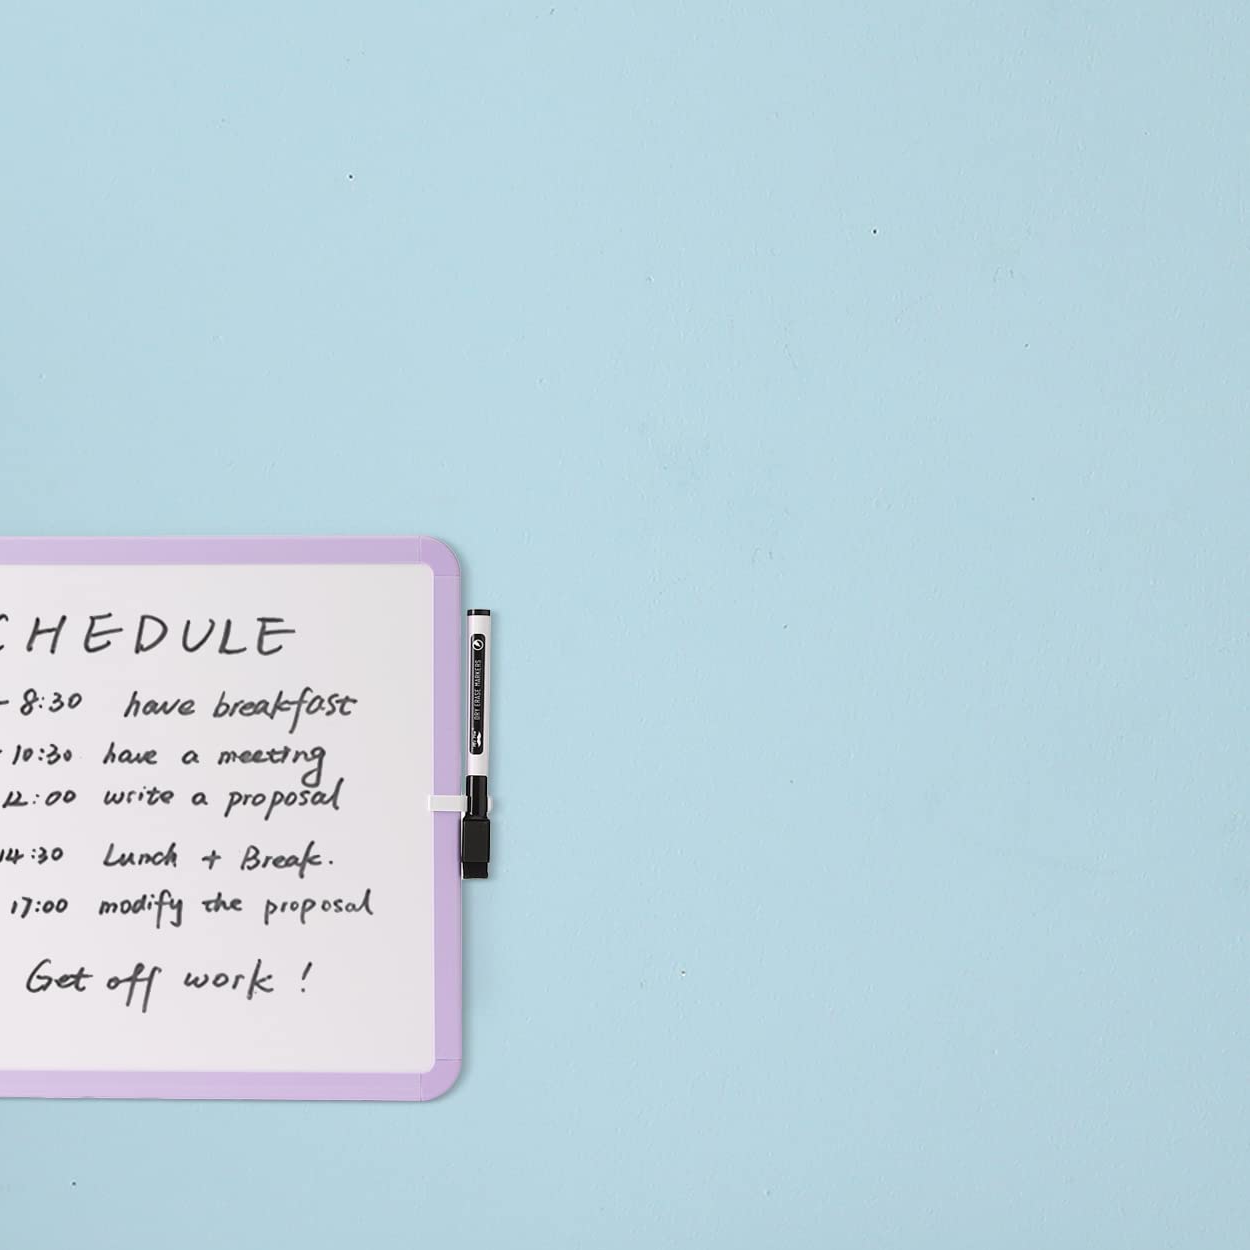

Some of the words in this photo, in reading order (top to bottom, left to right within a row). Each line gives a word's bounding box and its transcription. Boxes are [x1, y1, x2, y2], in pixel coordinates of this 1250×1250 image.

[474, 659, 482, 687] MARKERS
[19, 687, 83, 716] 8:30
[123, 690, 196, 718] have
[212, 686, 358, 735] breakfast
[473, 688, 482, 707] ERASE
[473, 708, 481, 721] DRY
[11, 744, 73, 766] 10:30
[102, 741, 158, 765] have
[181, 749, 200, 765] a
[217, 745, 327, 789] meeting
[103, 786, 175, 807] write
[191, 791, 209, 806] a
[223, 777, 345, 821] proposal
[102, 842, 178, 868] Lunch
[10, 896, 69, 919] 17:00
[98, 889, 184, 930] modify
[201, 891, 243, 913] the
[264, 888, 374, 926] proposal
[25, 958, 94, 994] Get
[106, 962, 163, 1014] off
[183, 958, 274, 1001] work
